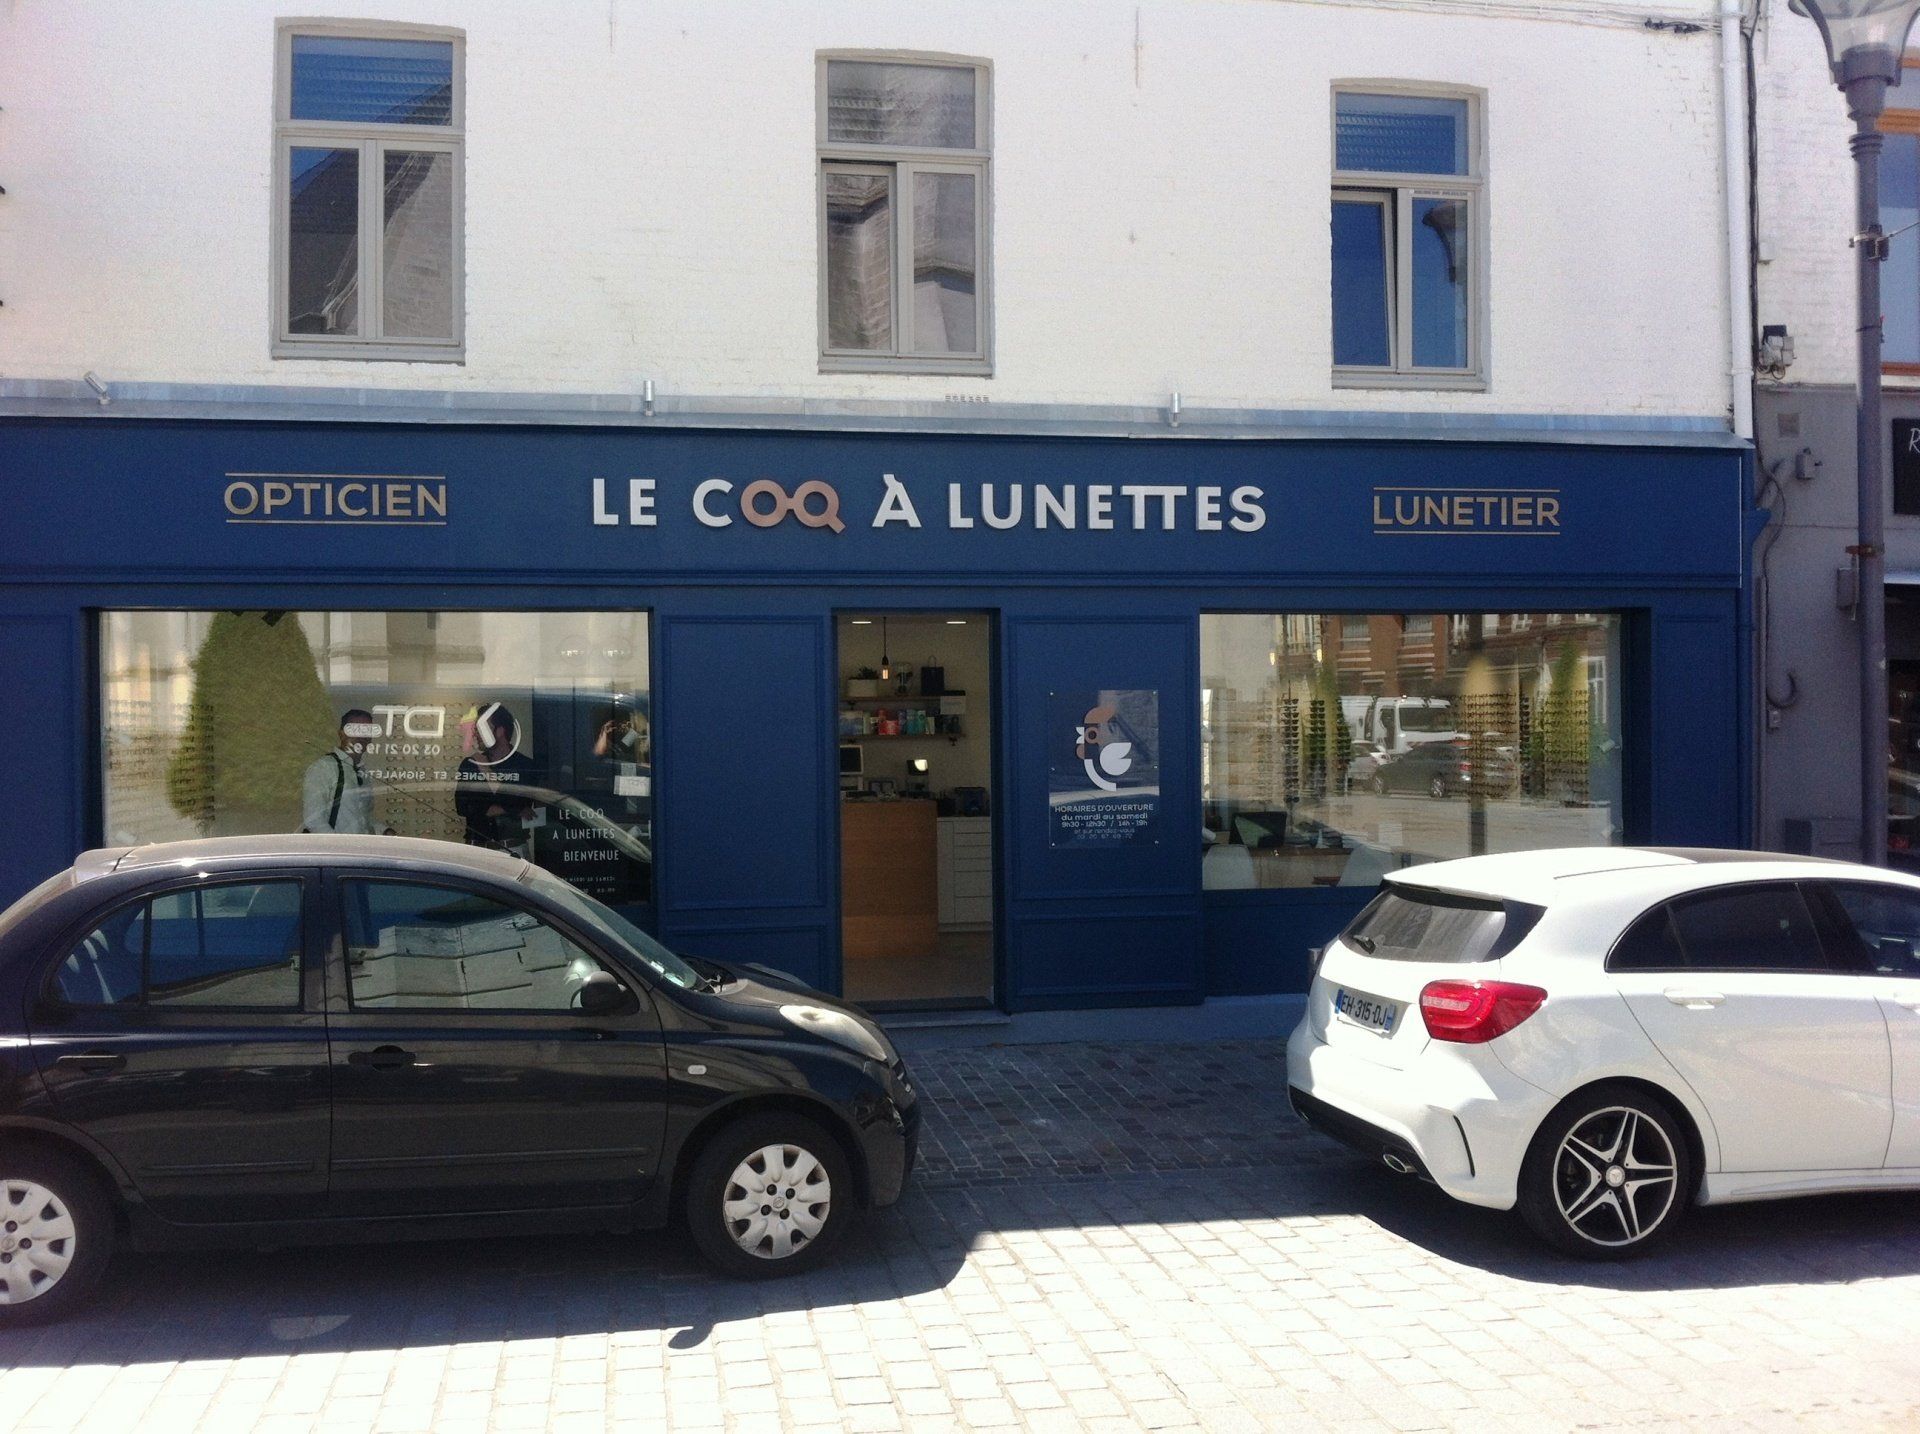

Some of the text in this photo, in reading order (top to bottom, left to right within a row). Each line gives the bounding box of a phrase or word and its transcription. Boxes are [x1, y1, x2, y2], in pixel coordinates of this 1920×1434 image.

[223, 480, 447, 517] OPTICIEN
[592, 473, 1267, 534] LE COQ À LUNETTES
[1373, 495, 1560, 527] LUNETIER
[559, 808, 604, 820] LE COQ
[1054, 803, 1154, 813] HORAIRES D'OUVERTURE
[1116, 812, 1148, 820] samedi
[552, 828, 616, 840] A LUNETTES
[564, 849, 620, 862] BIENVENUE
[1340, 994, 1388, 1026] EH-315-DJ
